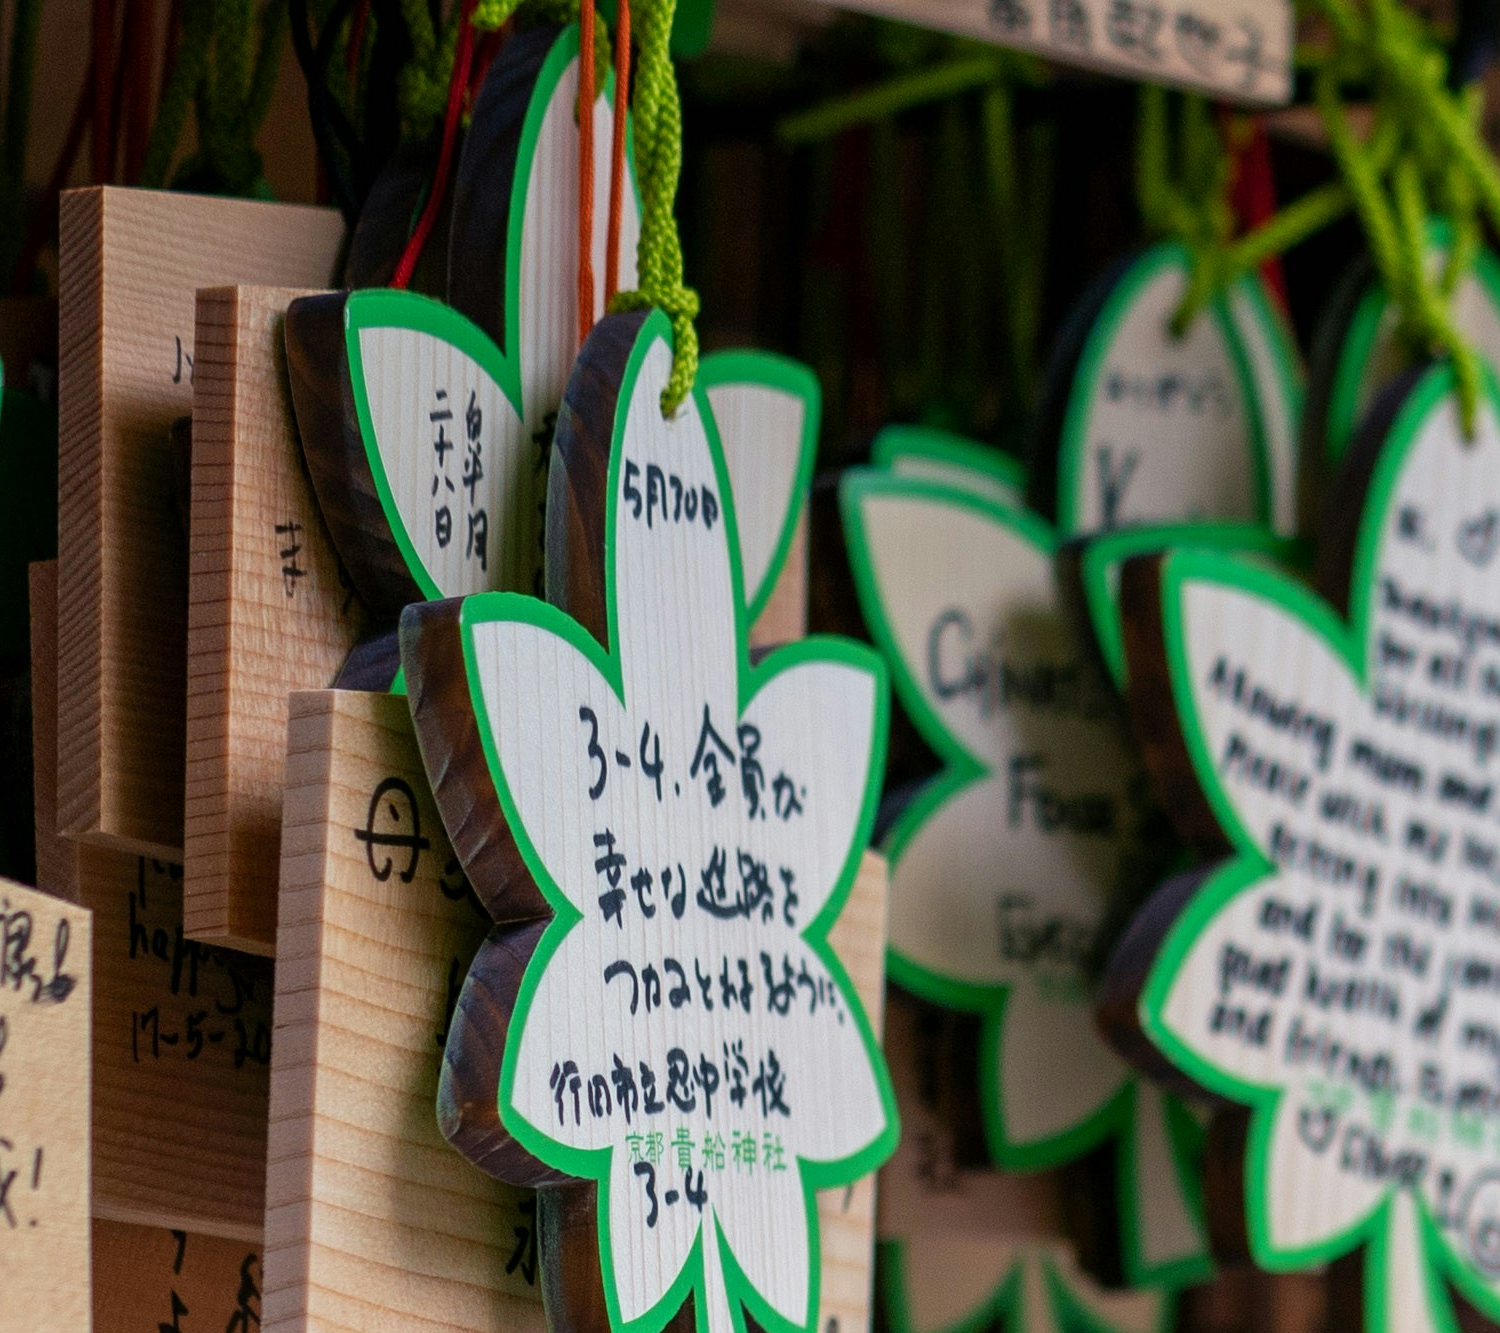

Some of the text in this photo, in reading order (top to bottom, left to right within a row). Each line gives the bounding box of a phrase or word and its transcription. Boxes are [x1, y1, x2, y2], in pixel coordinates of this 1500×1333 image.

[622, 457, 720, 531] 5月30日
[593, 827, 800, 930] 幸せな進路を
[1209, 1000, 1272, 1050] and
[624, 1125, 789, 1176] 京都貴船神社
[633, 1161, 709, 1228] 3-4
